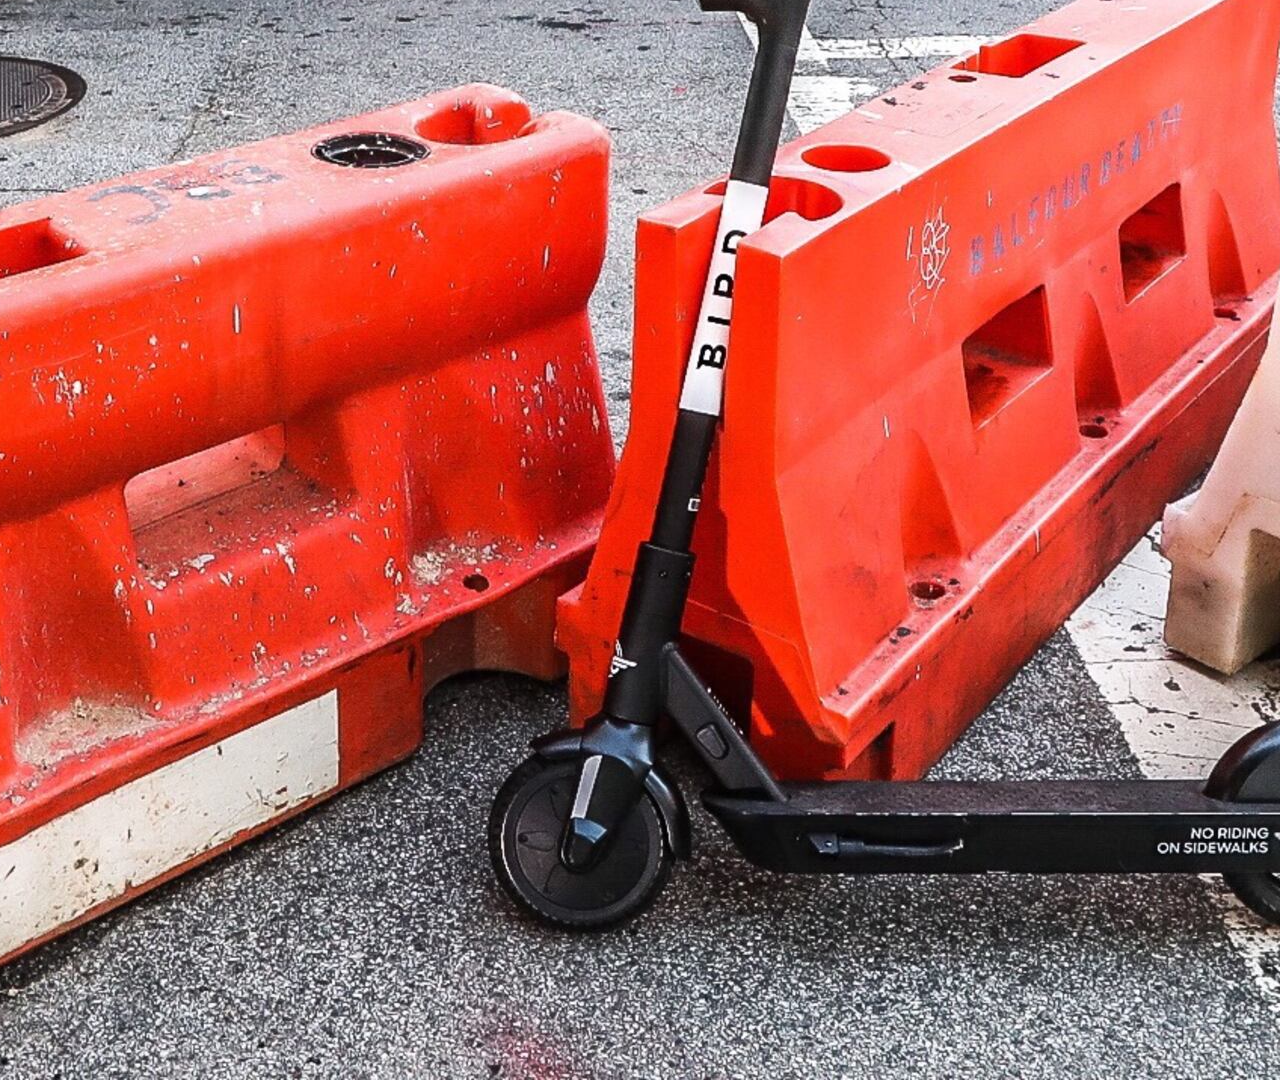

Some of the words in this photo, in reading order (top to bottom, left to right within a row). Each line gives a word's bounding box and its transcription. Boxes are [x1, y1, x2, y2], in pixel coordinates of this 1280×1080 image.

[970, 162, 1091, 277] BALFOUR
[1190, 827, 1214, 839] NO
[1218, 827, 1269, 839] RIDING
[1157, 842, 1180, 854] ON
[1183, 841, 1269, 854] SIDEWALKS
